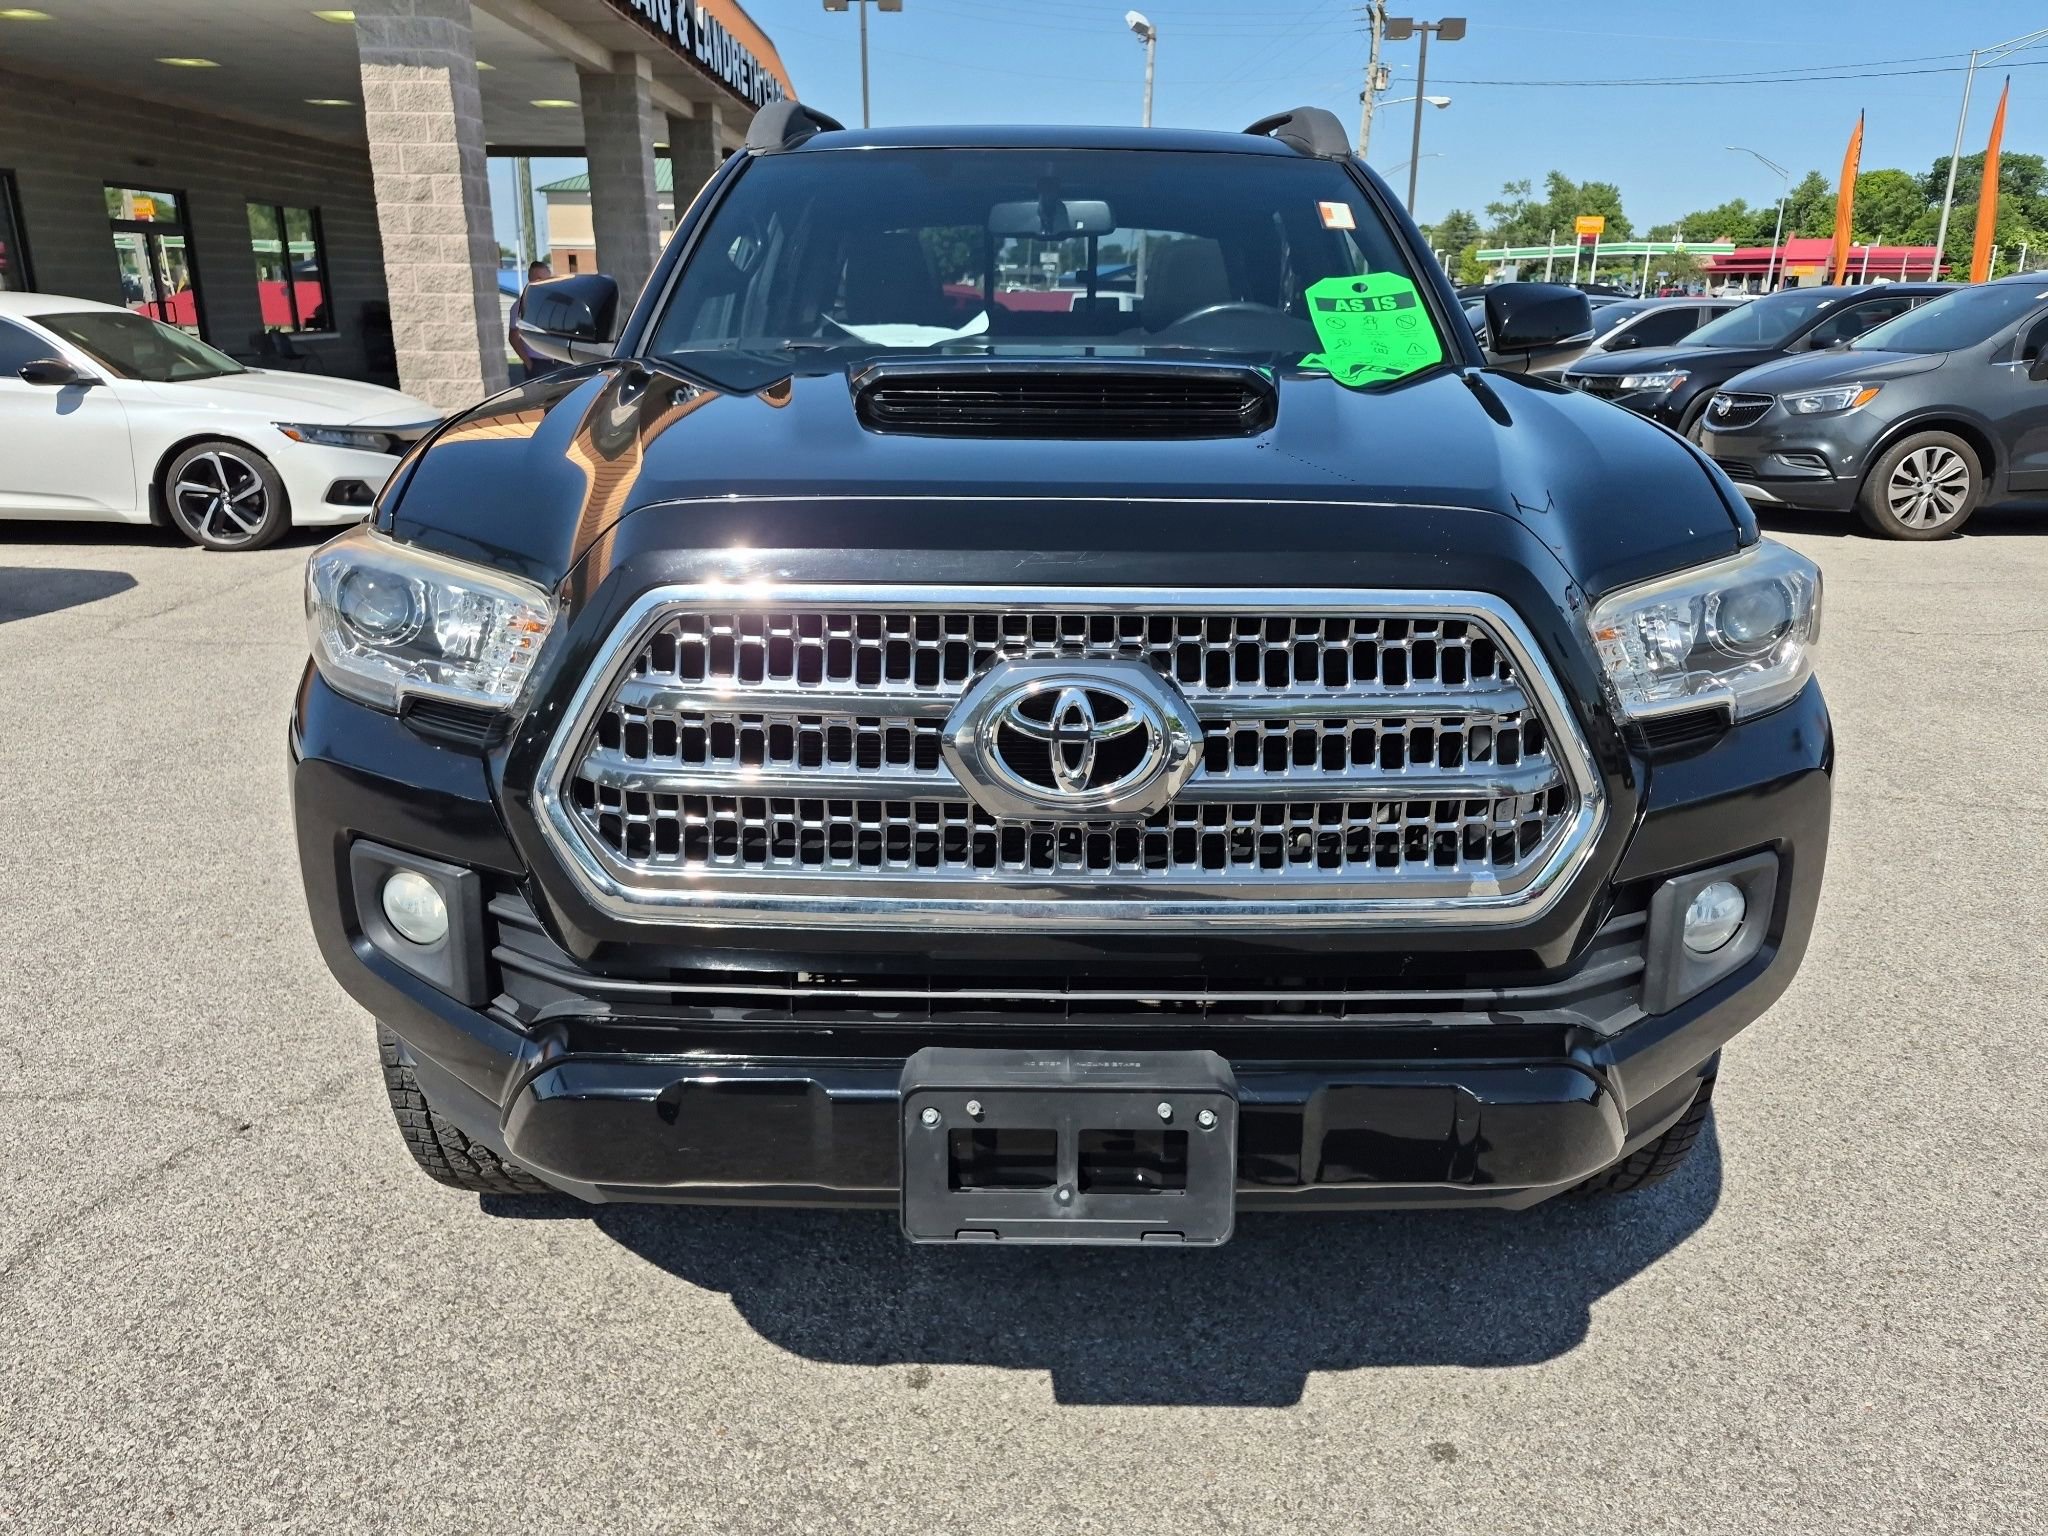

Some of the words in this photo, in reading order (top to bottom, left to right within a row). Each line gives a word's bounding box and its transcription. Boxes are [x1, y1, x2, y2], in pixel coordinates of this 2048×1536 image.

[677, 0, 690, 50] &
[694, 5, 763, 107] LANDRETH
[1335, 299, 1366, 312] AS
[1371, 296, 1397, 310] IS
